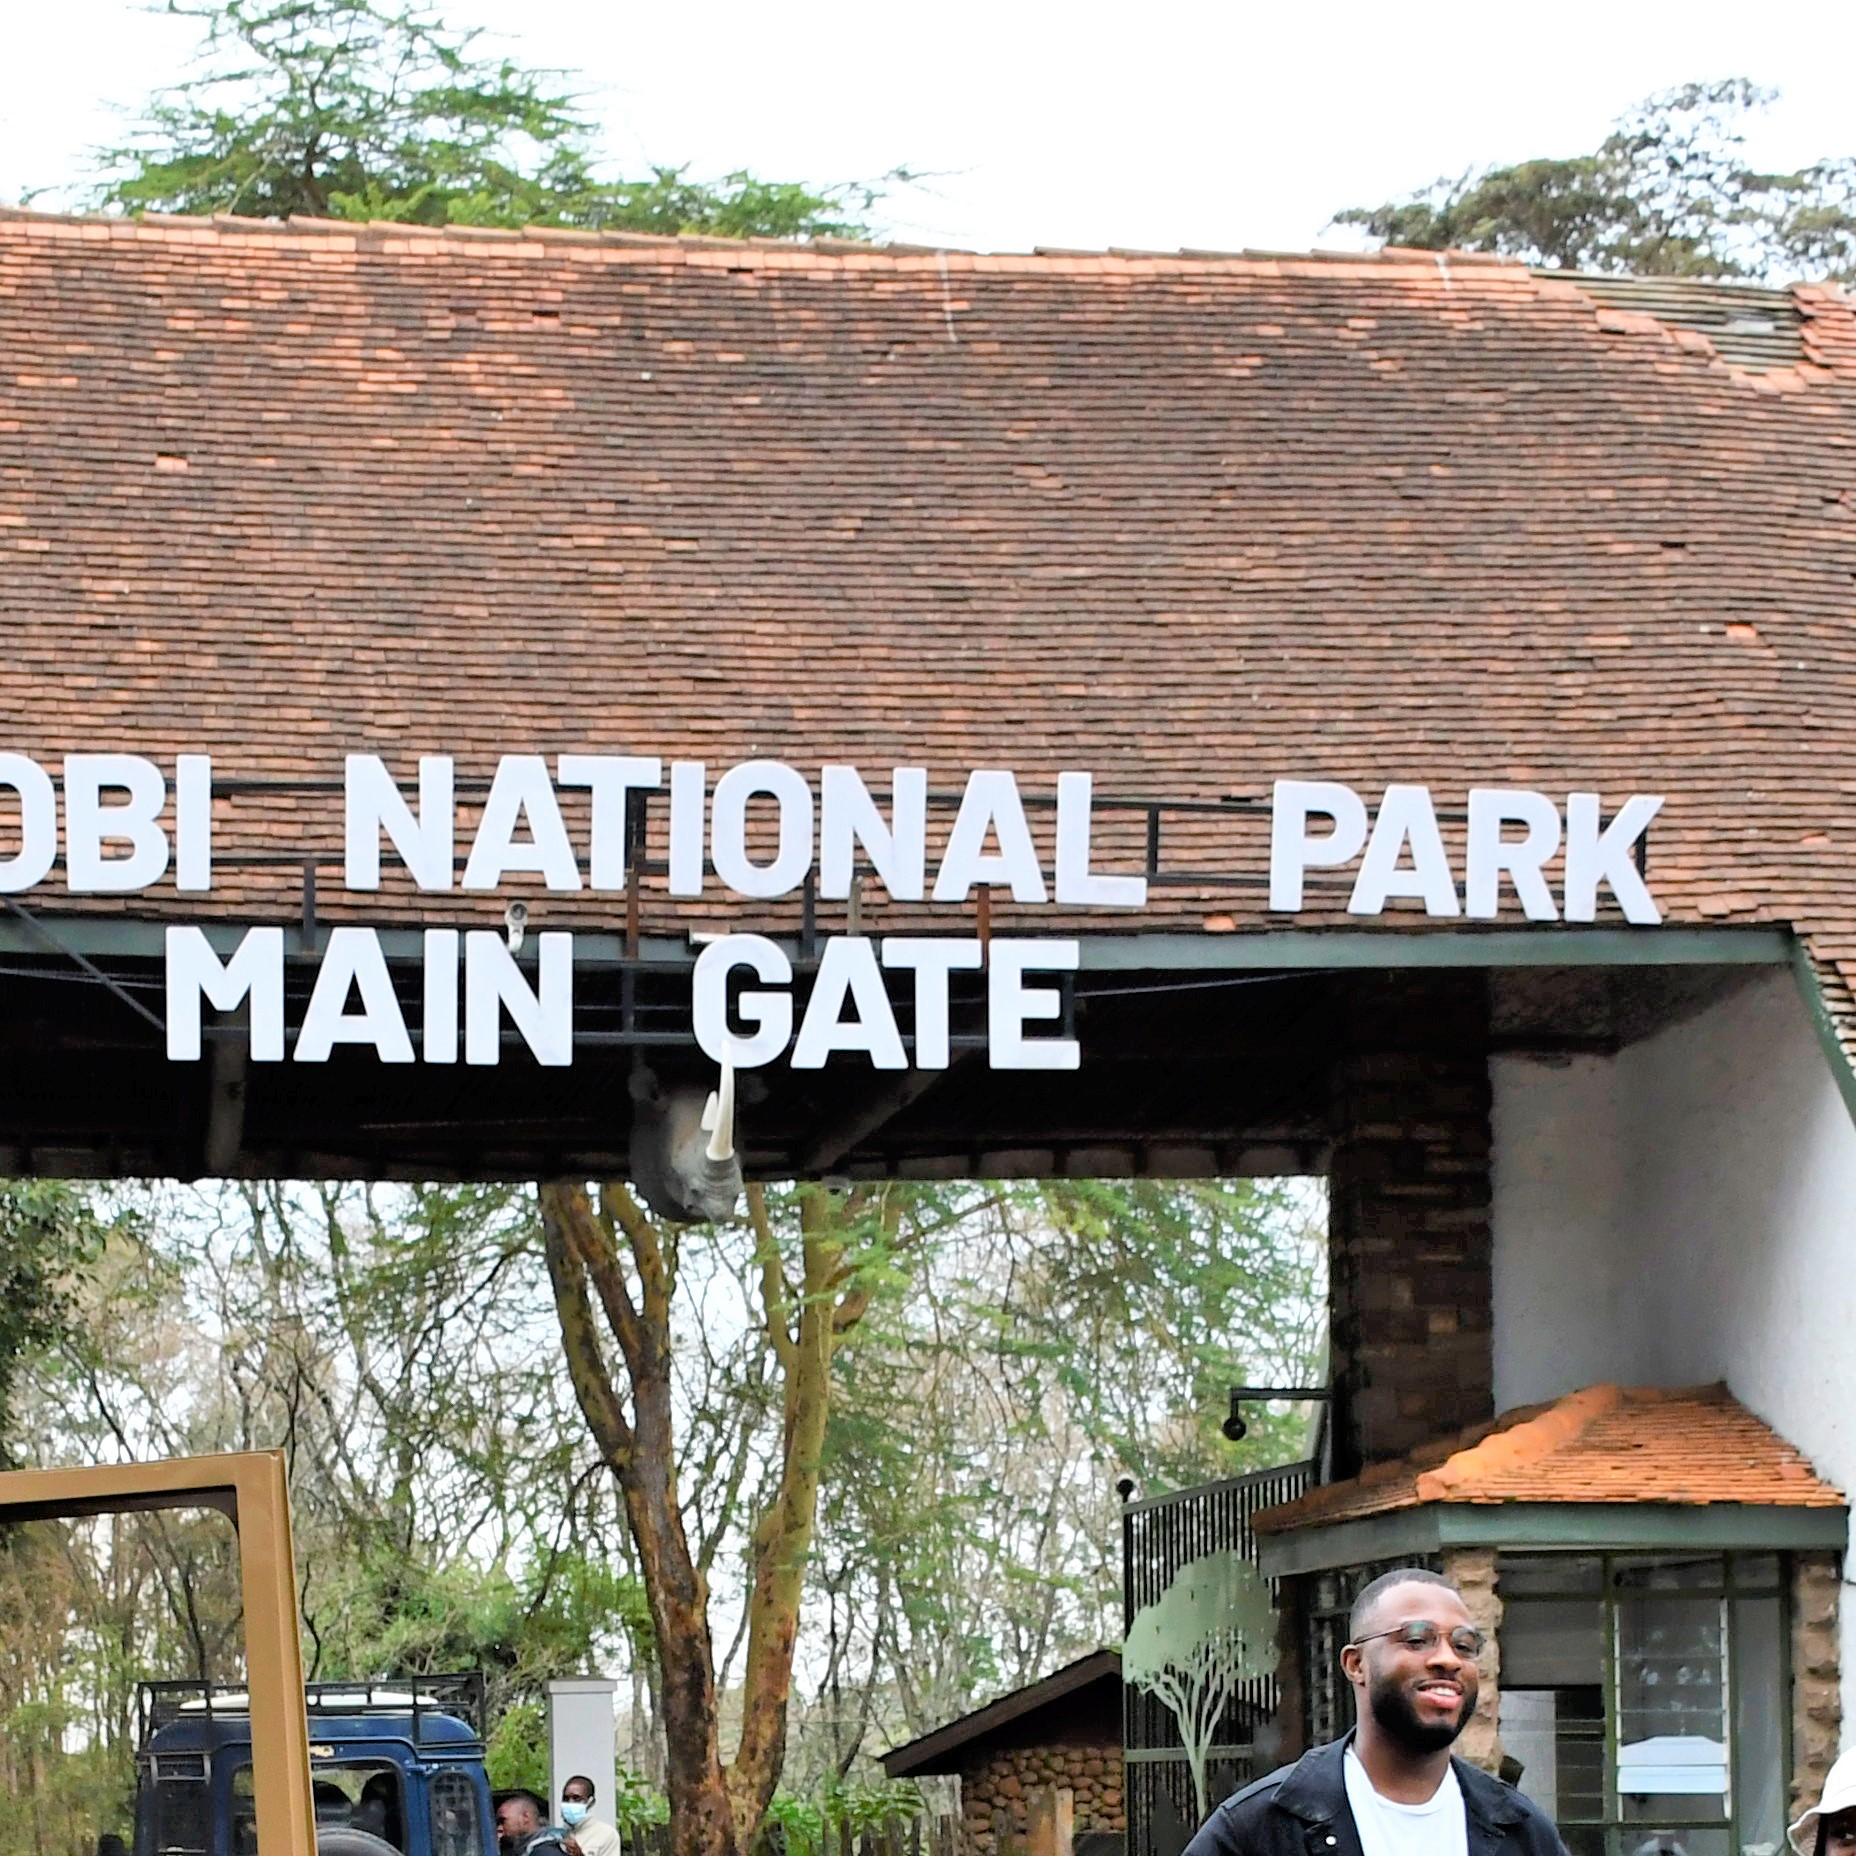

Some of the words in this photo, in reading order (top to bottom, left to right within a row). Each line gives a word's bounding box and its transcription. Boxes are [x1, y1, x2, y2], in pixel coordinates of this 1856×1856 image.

[345, 753, 1146, 907] NATIONAL
[1269, 779, 1666, 924] PARK
[164, 926, 573, 1066] MAIN
[692, 933, 1080, 1070] GATE
